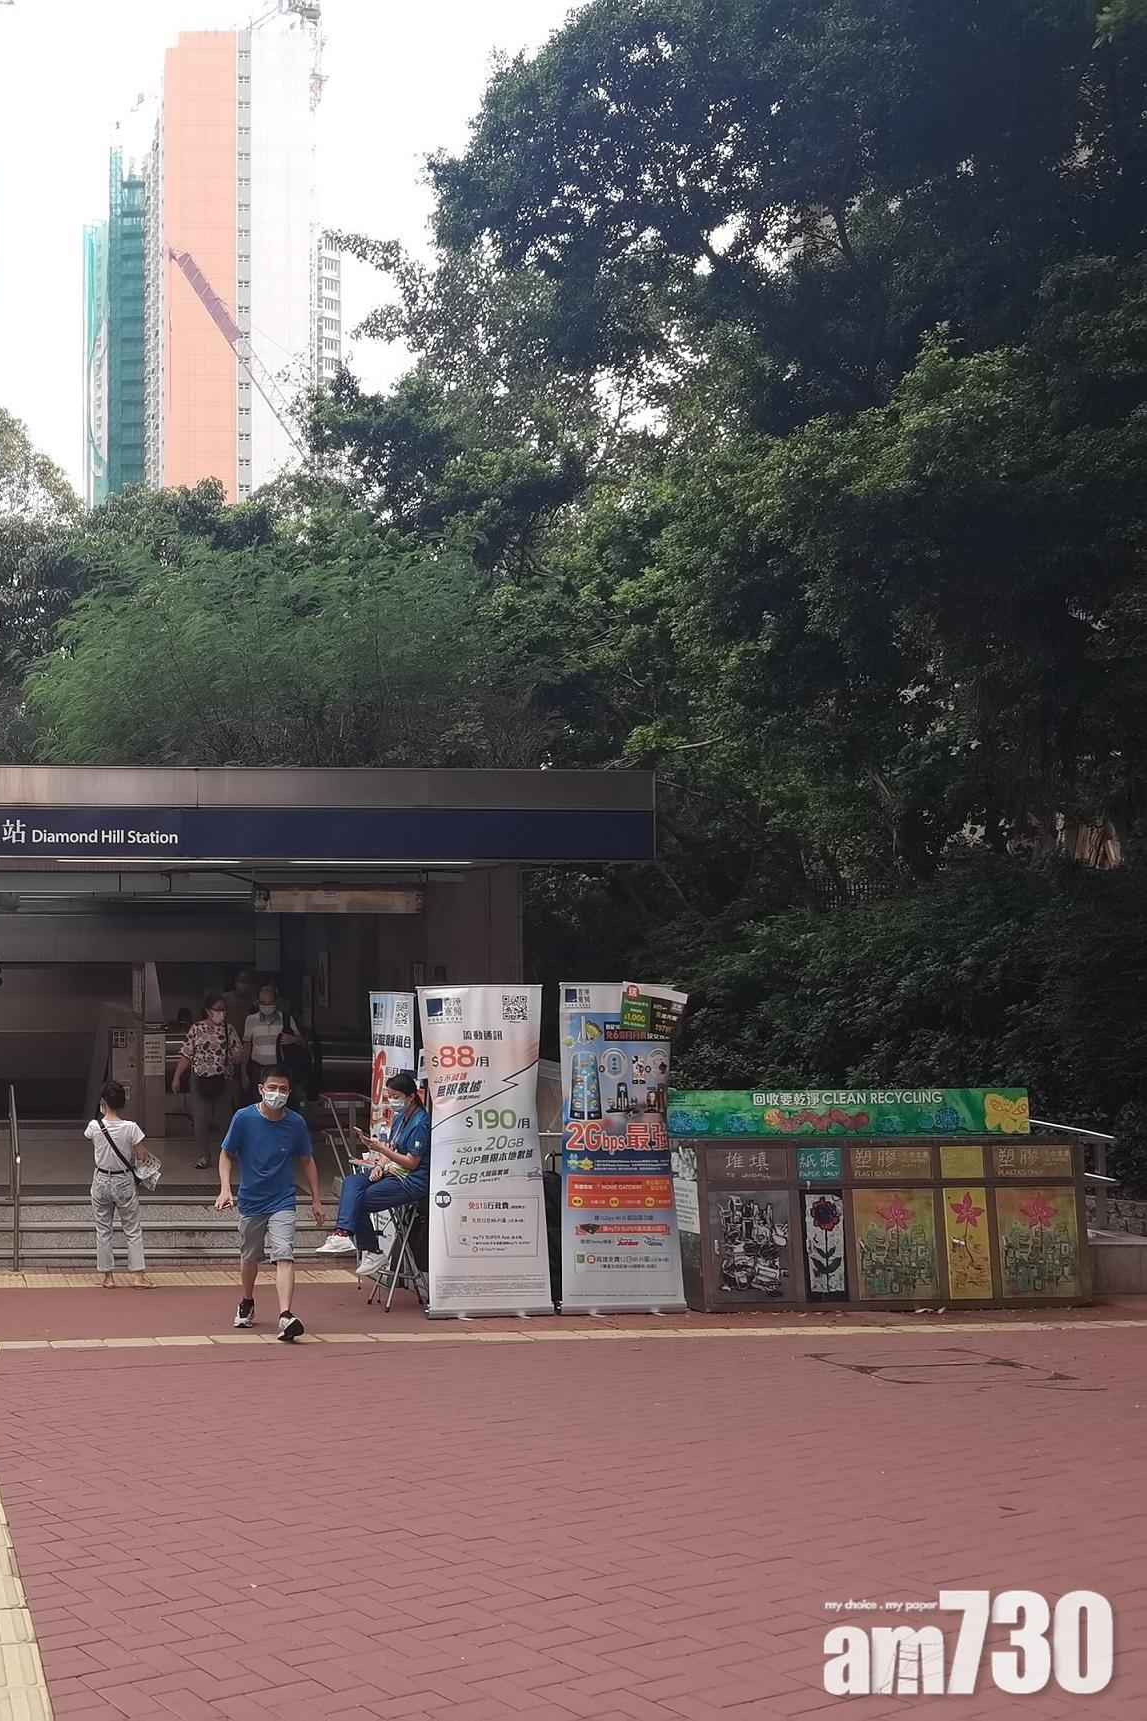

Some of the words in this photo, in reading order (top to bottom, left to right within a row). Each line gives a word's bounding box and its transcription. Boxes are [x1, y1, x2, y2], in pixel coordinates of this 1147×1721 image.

[31, 829, 98, 844] Diamond
[101, 829, 124, 844] Hill
[127, 829, 179, 844] Station
[753, 1092, 820, 1106] 回收要乾淨
[822, 1092, 867, 1105] CLEAN
[870, 1091, 943, 1105] RECYCLING
[484, 1135, 525, 1151] 20GB
[725, 1151, 771, 1171] 堆填
[799, 1150, 839, 1169] 紙張
[855, 1149, 898, 1169] 塑膠
[998, 1148, 1039, 1167] 塑膠
